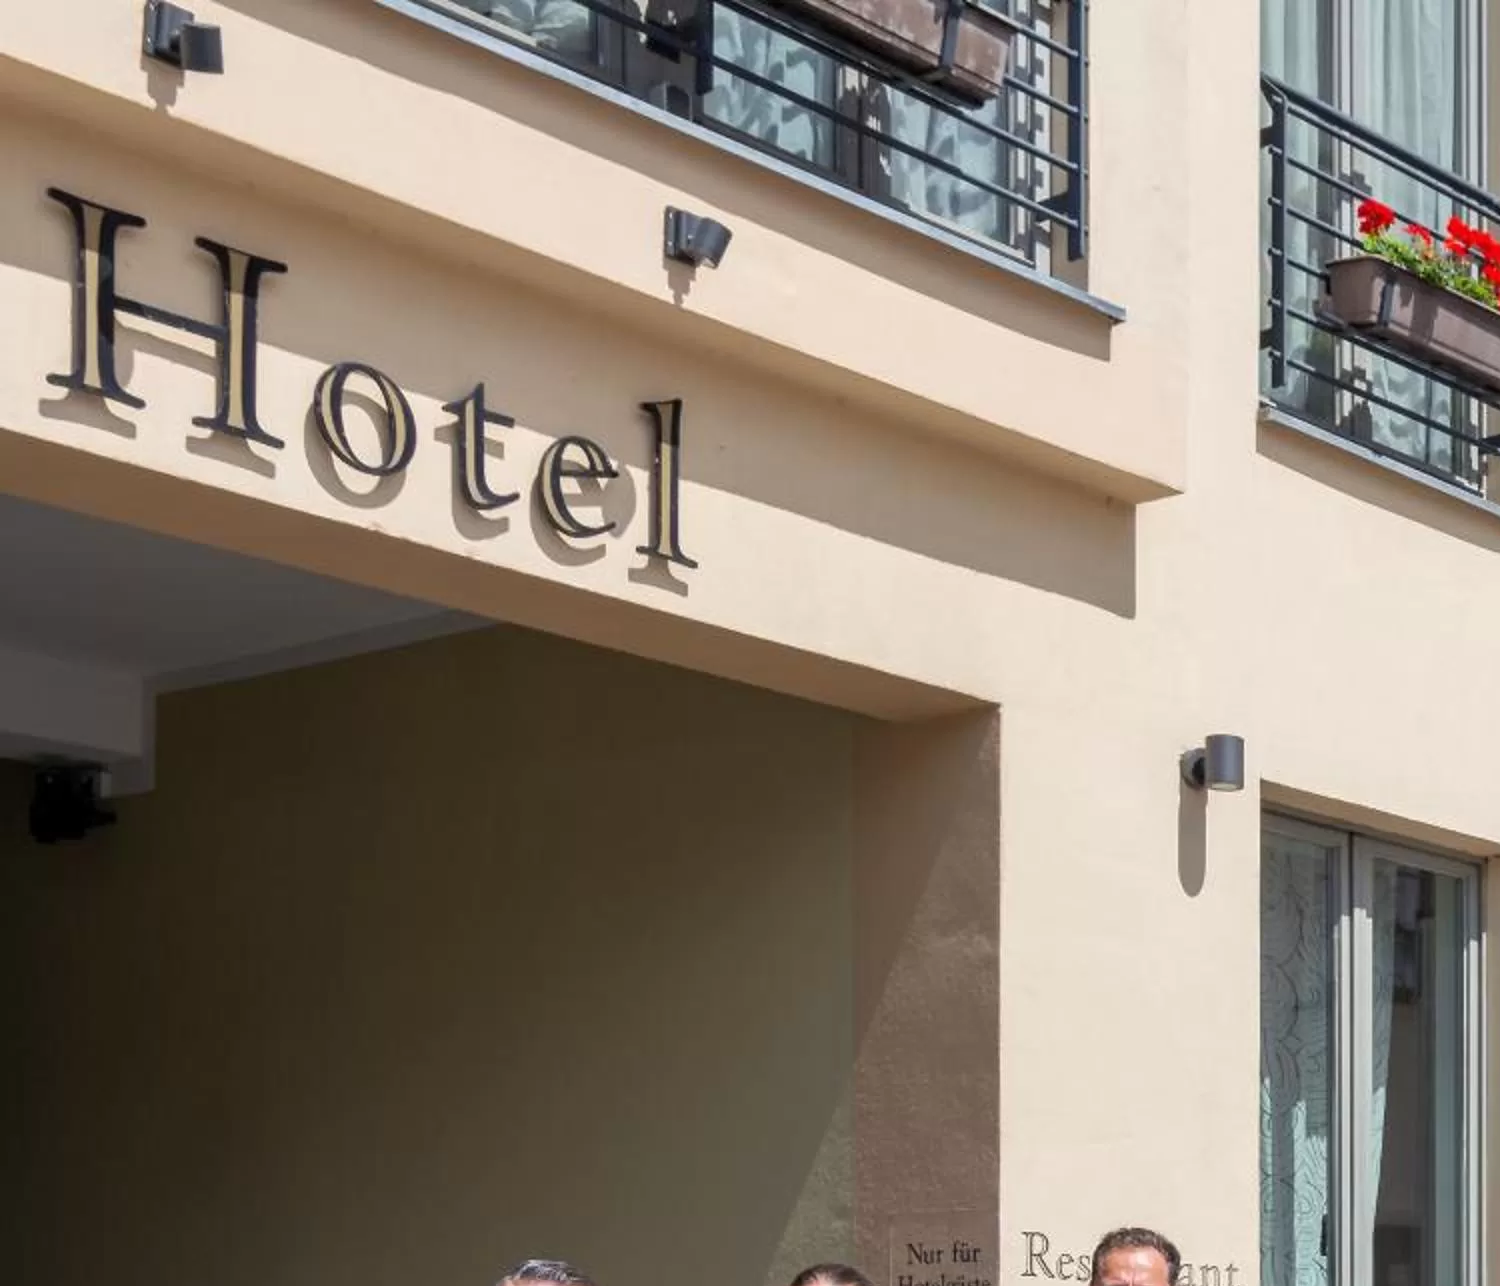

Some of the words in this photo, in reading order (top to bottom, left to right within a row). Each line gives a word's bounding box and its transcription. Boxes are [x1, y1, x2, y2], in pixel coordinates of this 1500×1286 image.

[47, 187, 698, 569] Hotel
[906, 1243, 944, 1265] Nur
[952, 1240, 983, 1263] für
